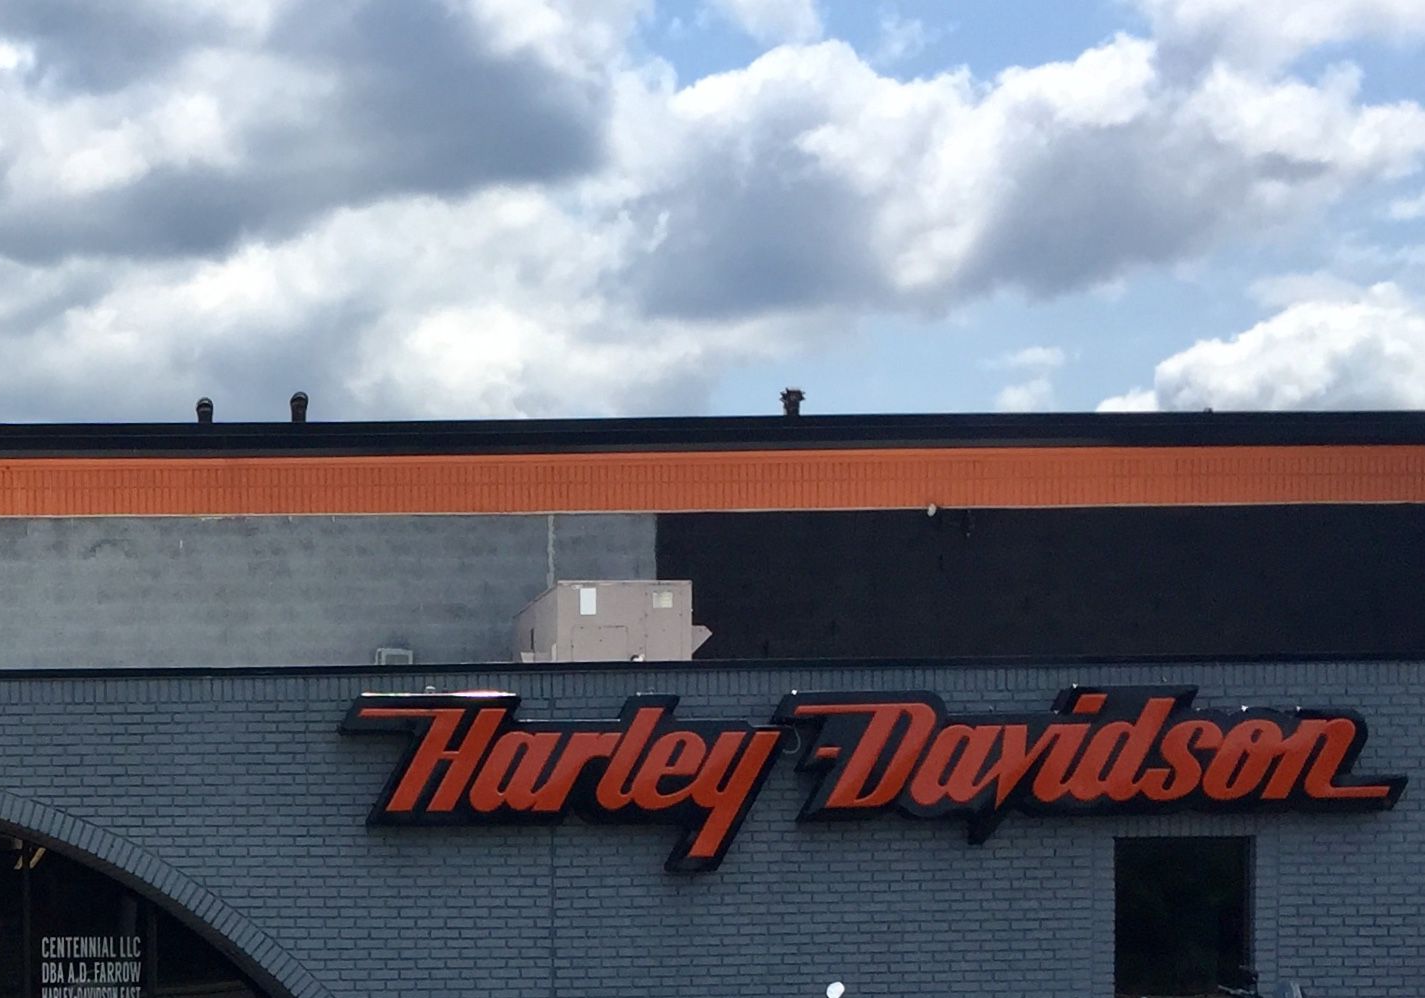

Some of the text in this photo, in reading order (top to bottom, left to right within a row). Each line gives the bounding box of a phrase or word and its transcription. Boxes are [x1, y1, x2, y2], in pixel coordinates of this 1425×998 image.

[41, 936, 142, 958] CENTENNIAL LLC
[41, 961, 142, 983] DBA A.D. FARROW
